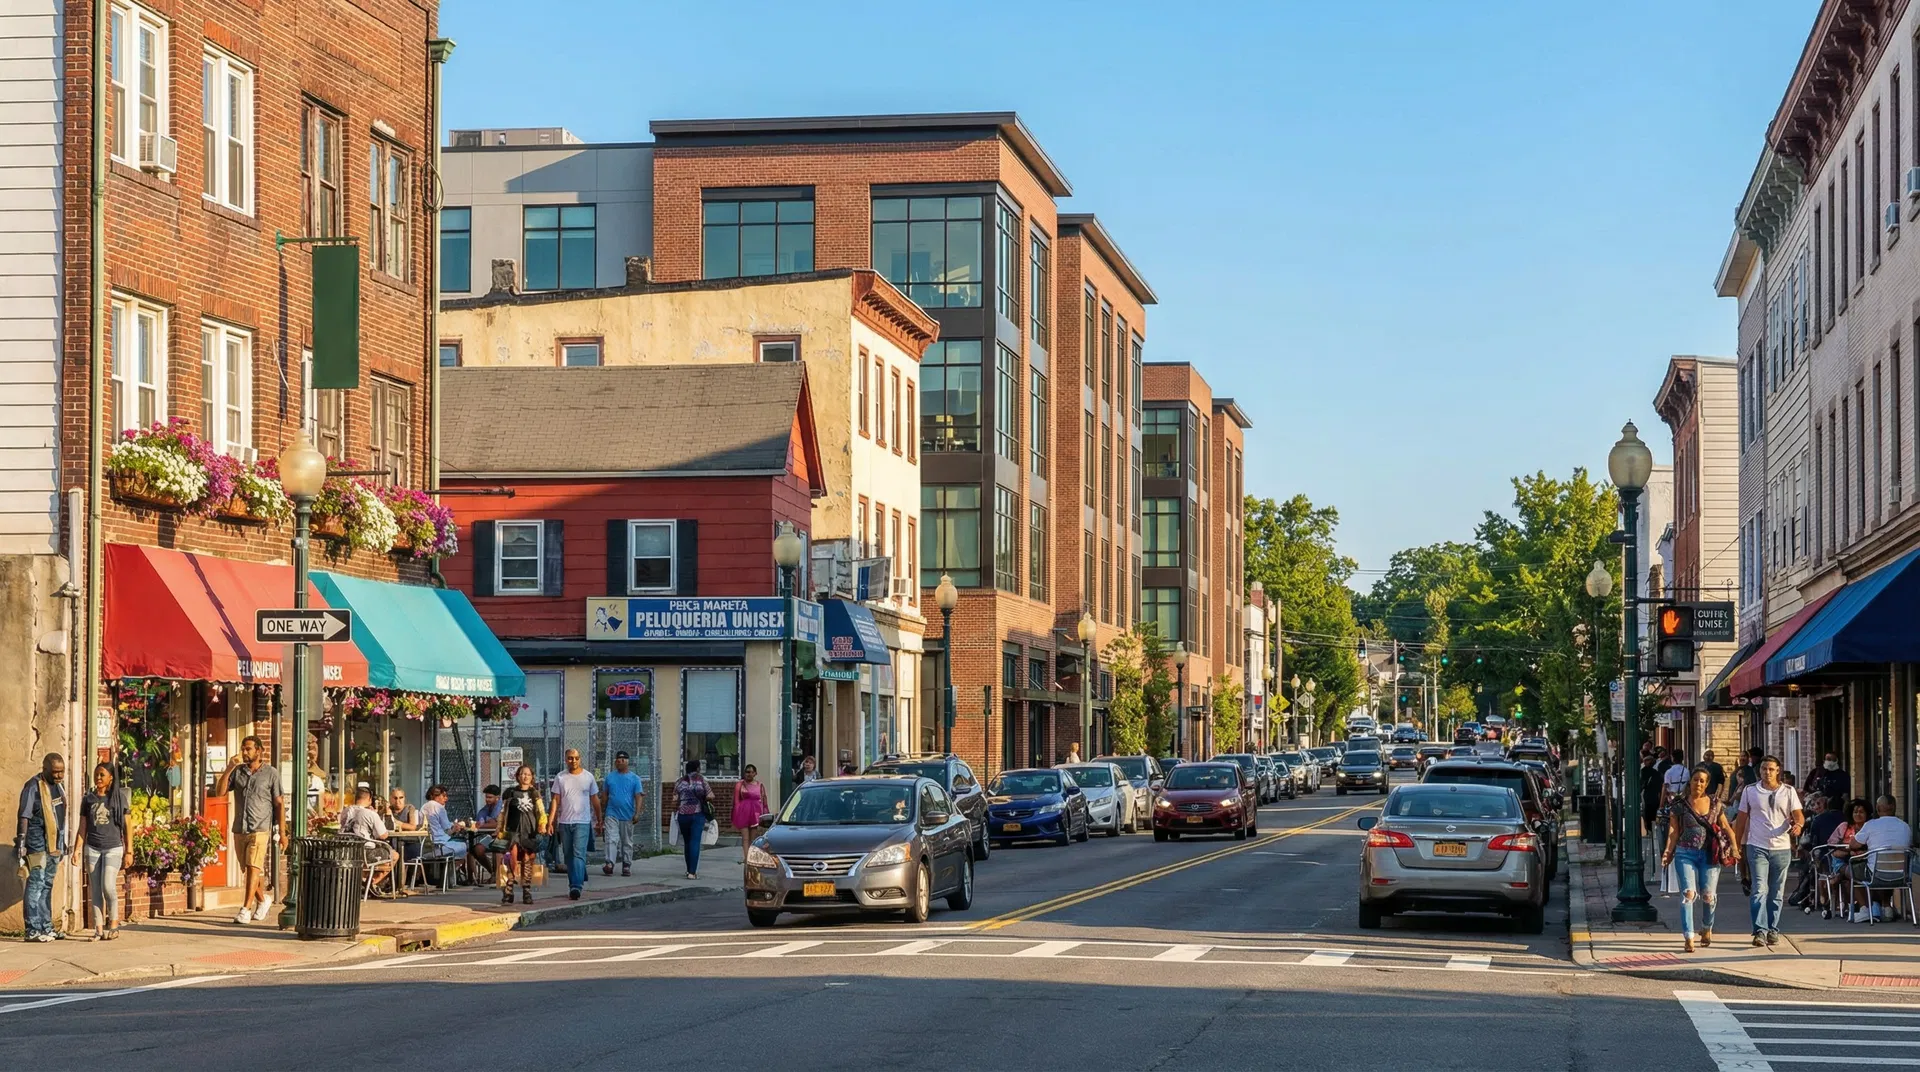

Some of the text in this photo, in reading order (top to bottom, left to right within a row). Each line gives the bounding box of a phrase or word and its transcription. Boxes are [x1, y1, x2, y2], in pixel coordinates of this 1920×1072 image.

[703, 600, 748, 611] MARETA
[267, 620, 327, 633] ONE WAY
[636, 611, 727, 630] PELUQUERIA
[732, 611, 785, 628] UNISEX
[606, 684, 645, 697] OPEN
